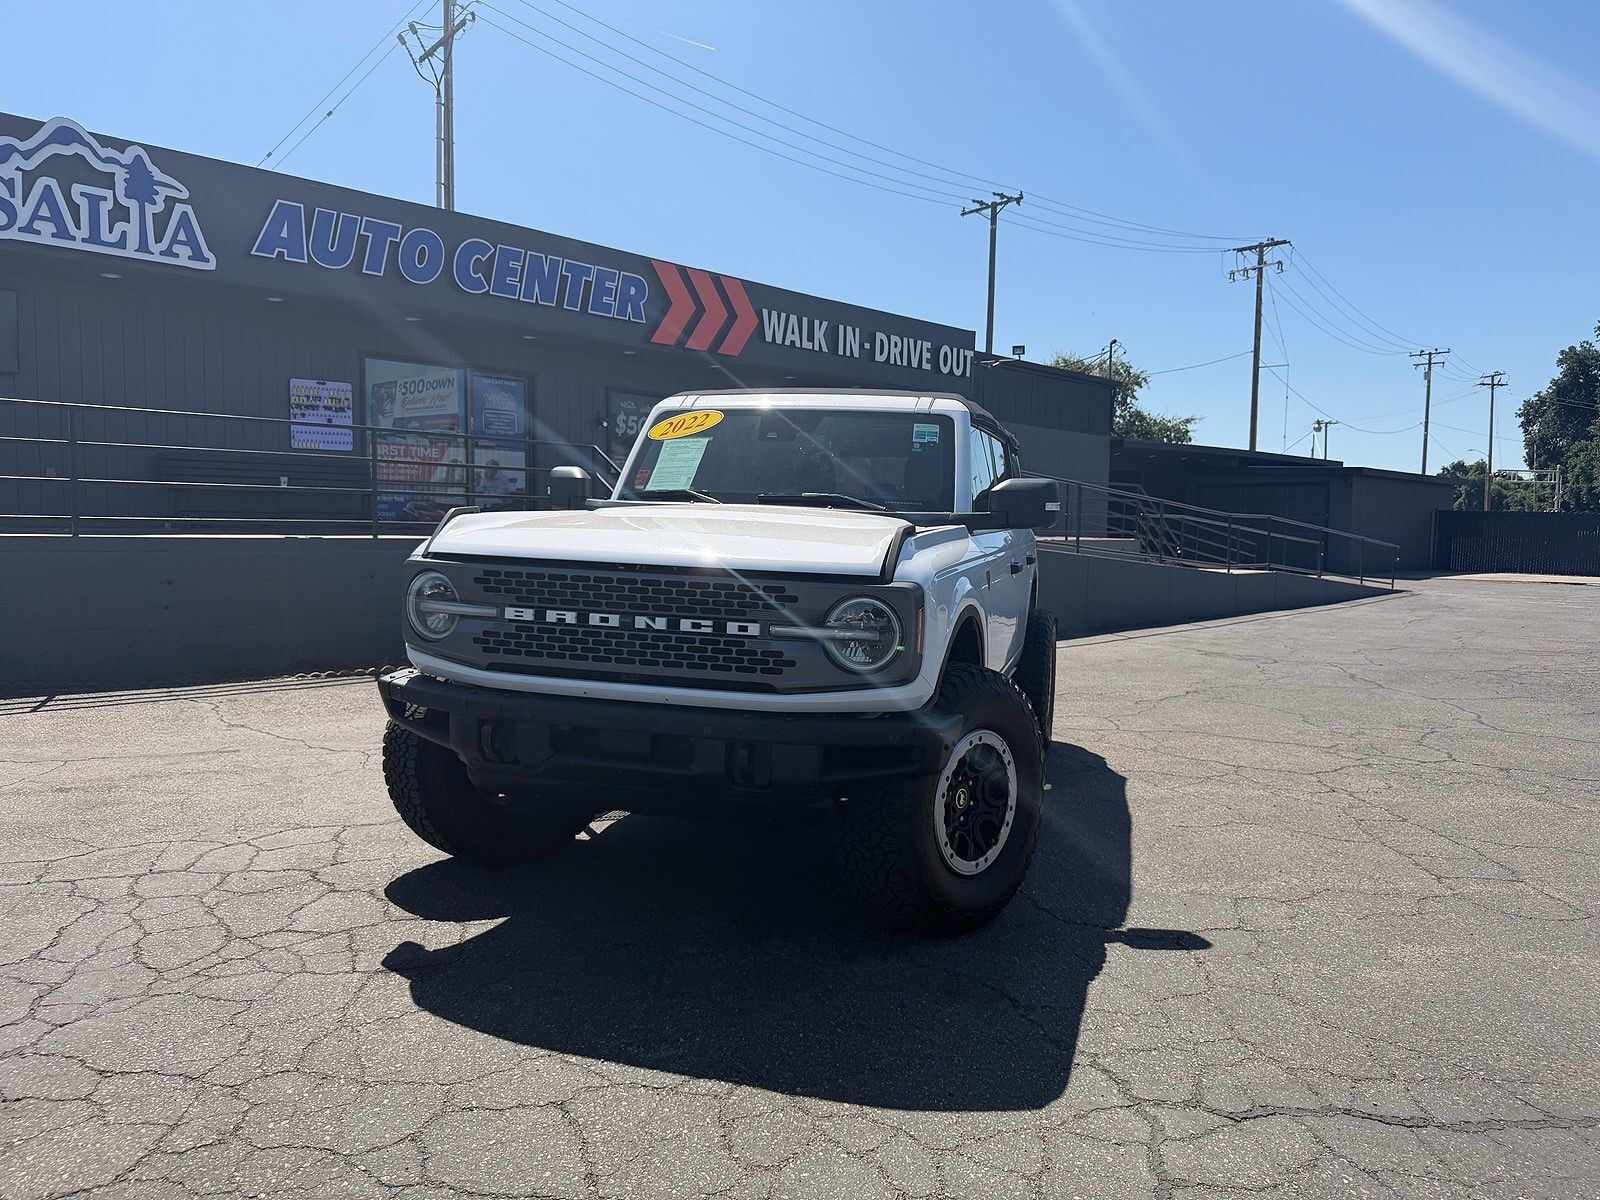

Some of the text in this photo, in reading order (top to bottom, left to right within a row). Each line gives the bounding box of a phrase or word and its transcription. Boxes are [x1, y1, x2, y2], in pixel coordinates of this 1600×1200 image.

[251, 199, 649, 323] AUTO CENTER
[762, 308, 828, 353] WALK
[939, 345, 974, 378] OUT
[398, 377, 455, 396] $500 DOWN
[659, 413, 710, 437] 2022
[409, 446, 440, 458] TIME
[504, 606, 761, 636] BRONCO
